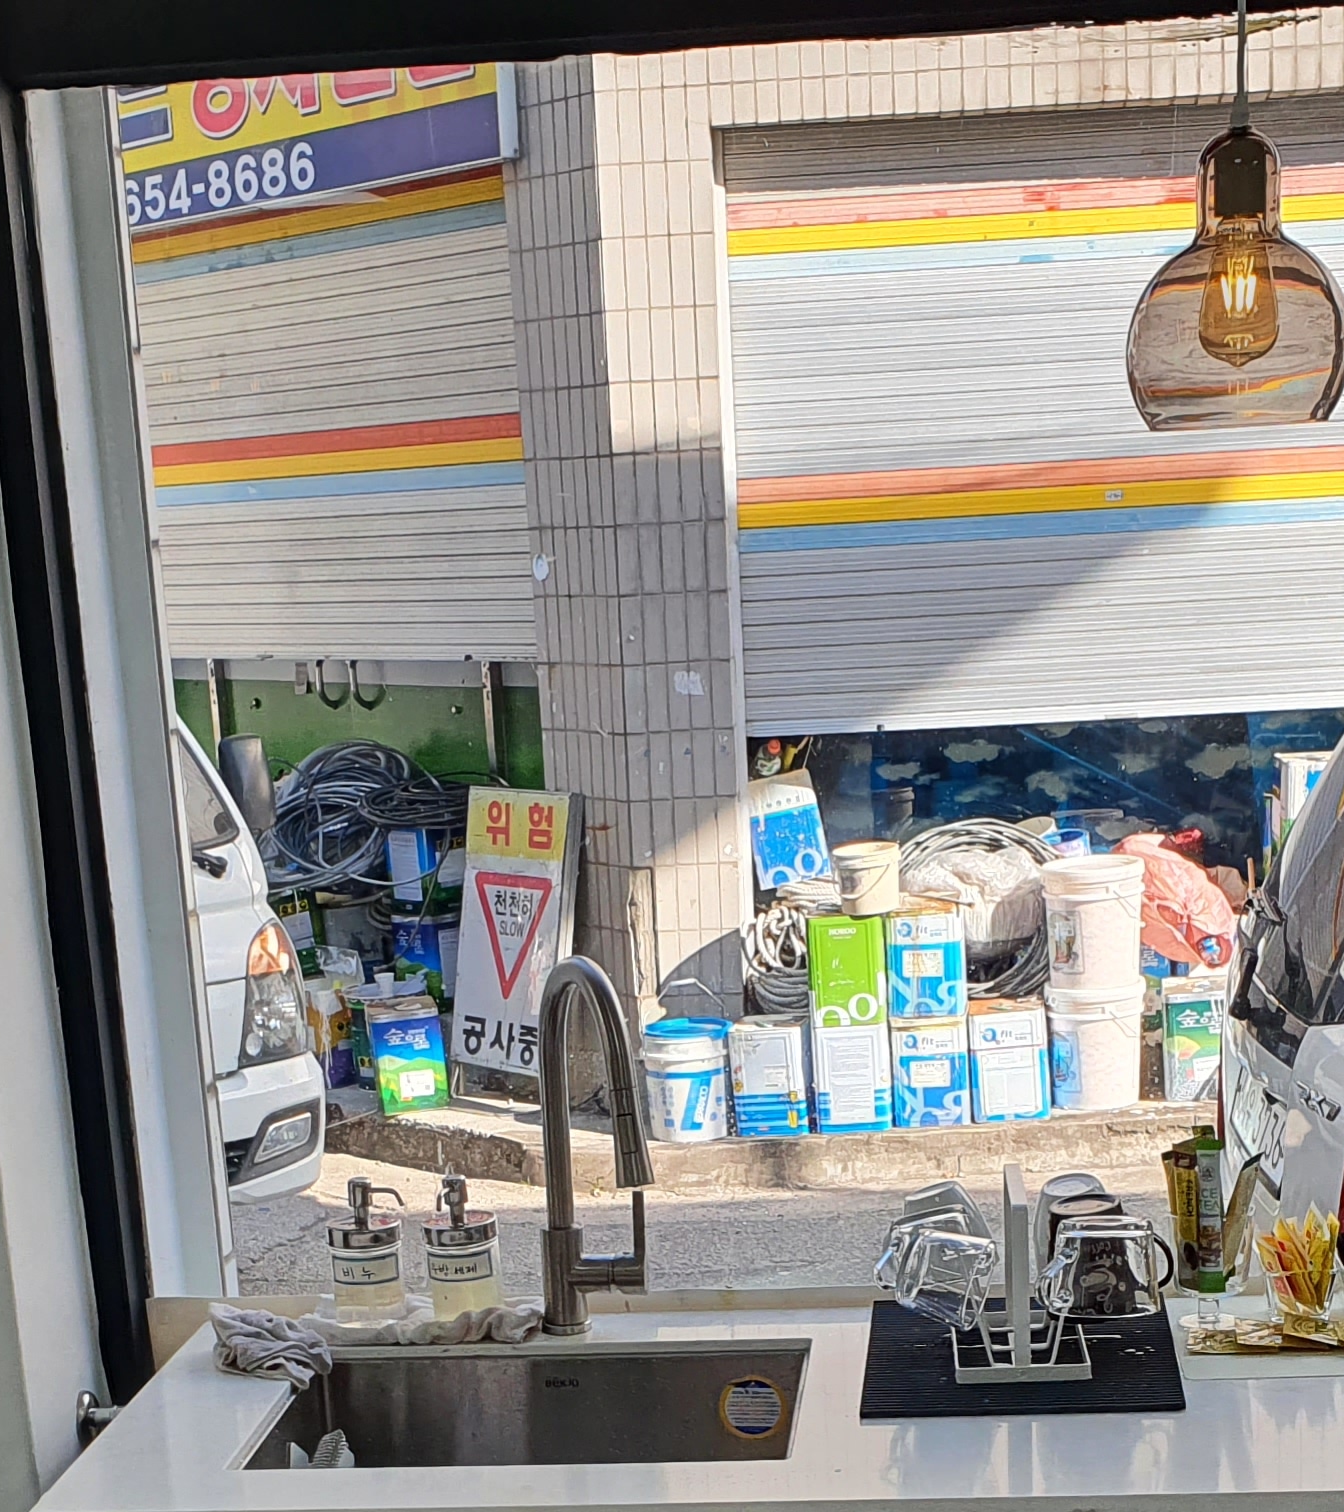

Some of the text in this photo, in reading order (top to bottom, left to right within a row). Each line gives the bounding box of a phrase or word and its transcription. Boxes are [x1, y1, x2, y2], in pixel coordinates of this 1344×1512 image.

[126, 142, 315, 225] 654-8686
[486, 800, 553, 850] 위험
[494, 890, 533, 922] 천천히
[499, 920, 525, 938] SLOW
[462, 1016, 538, 1067] 공사중
[342, 1266, 375, 1280] 비누
